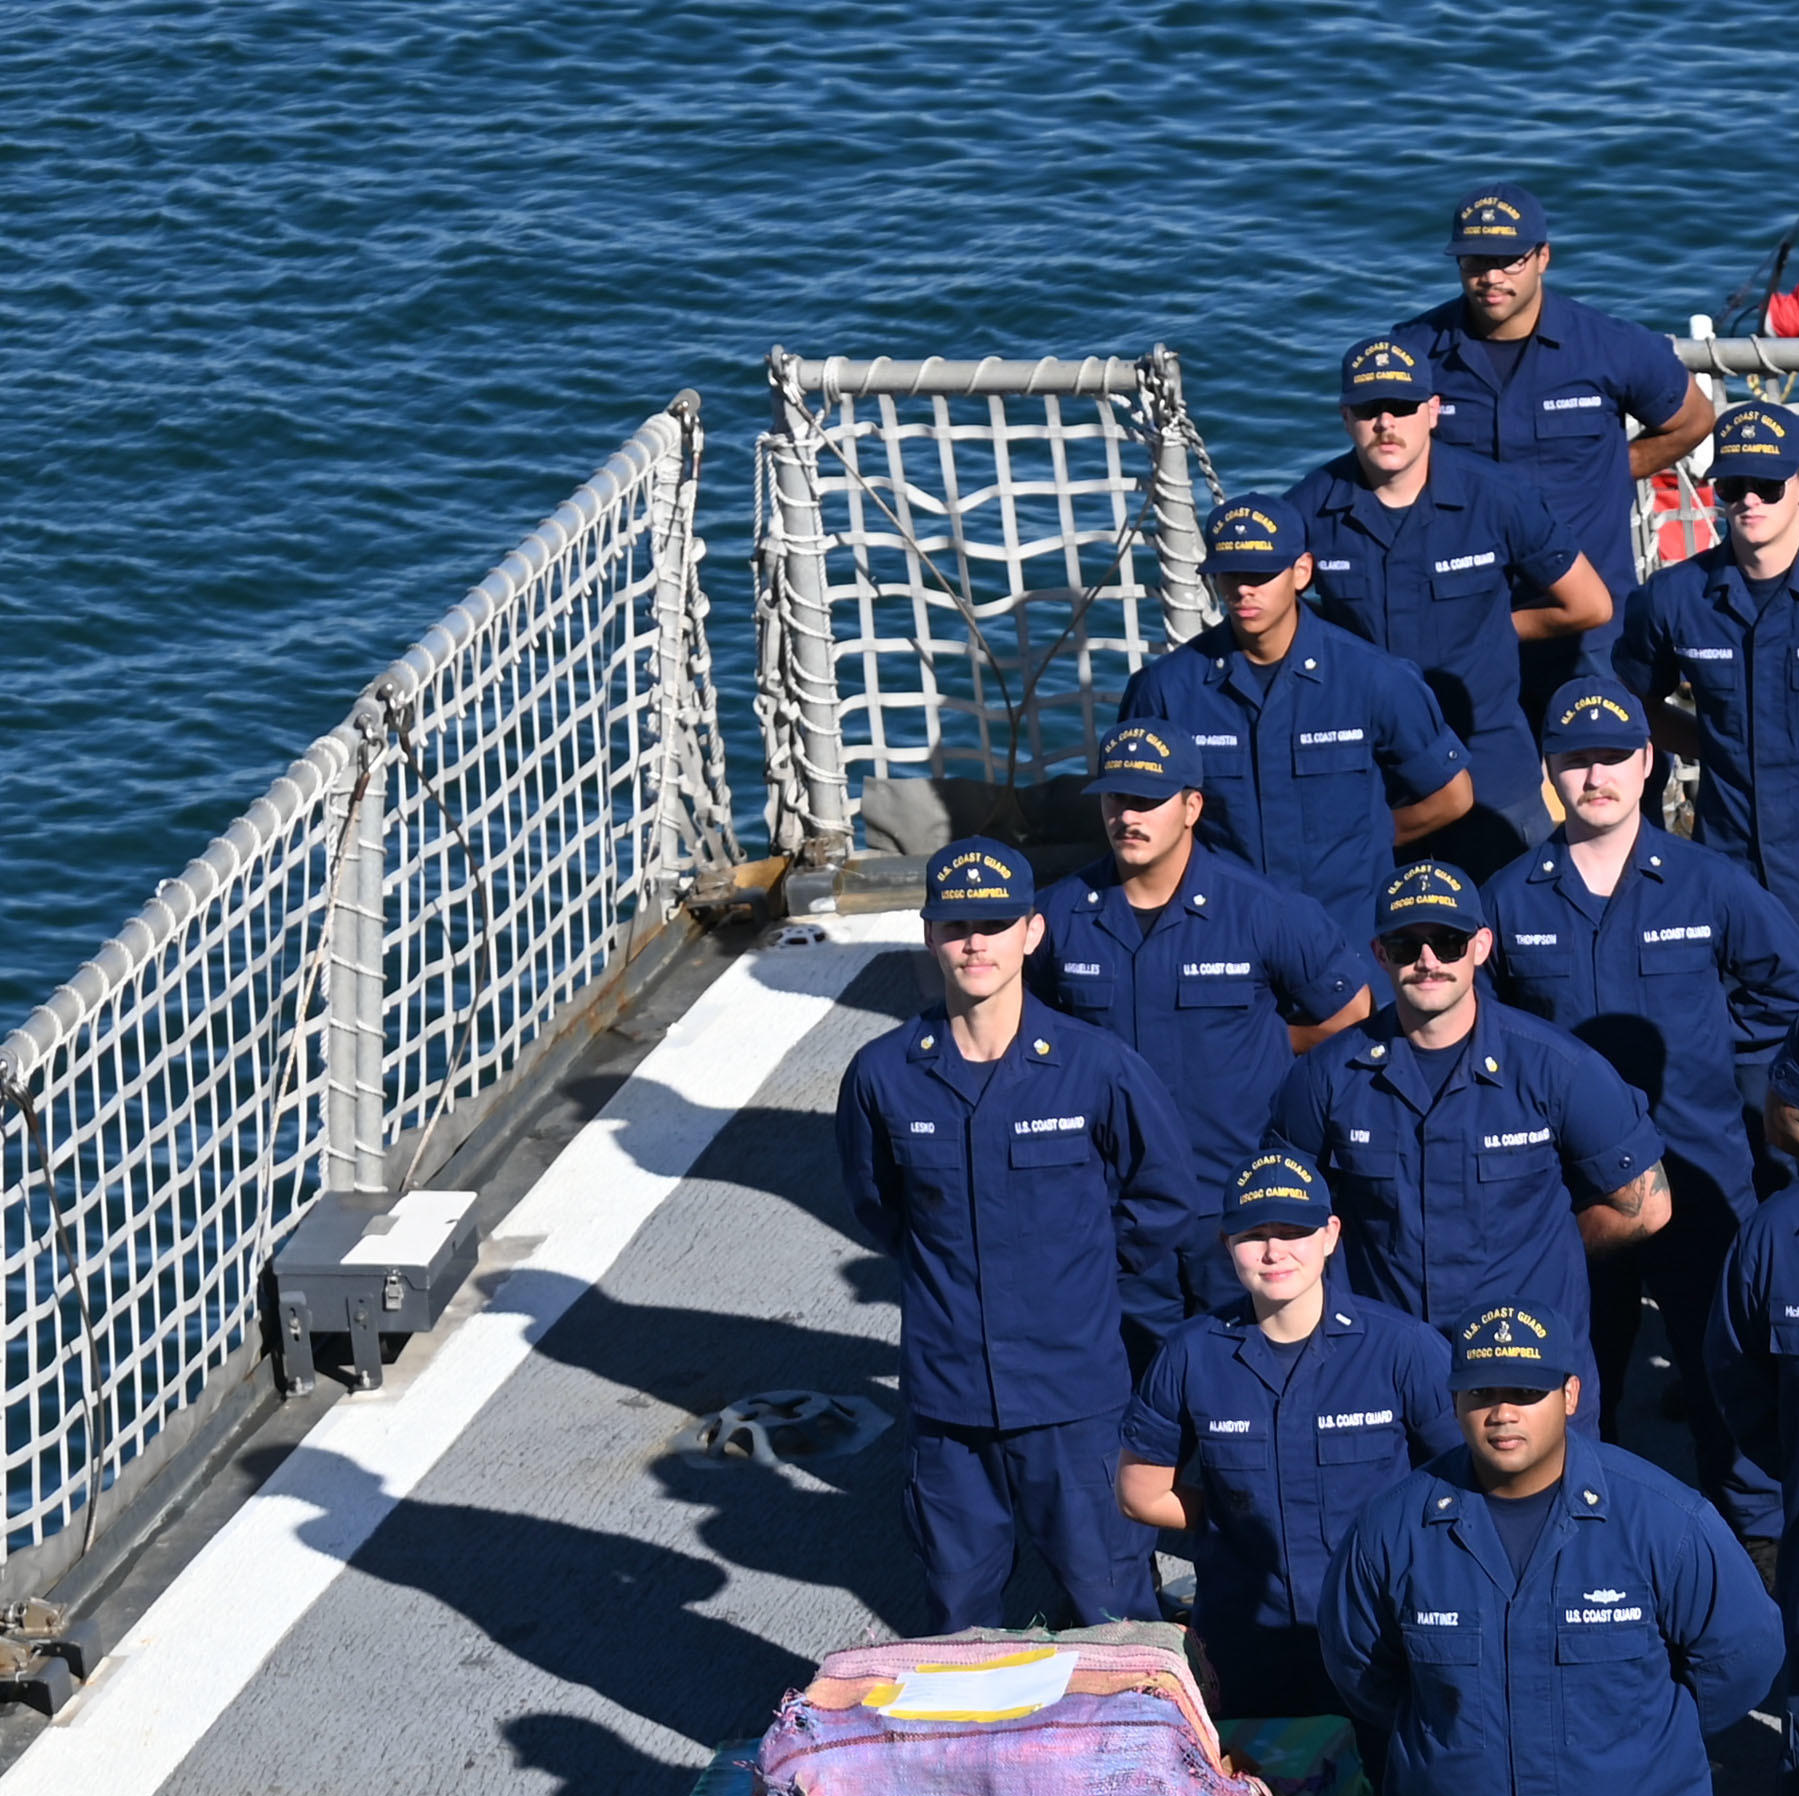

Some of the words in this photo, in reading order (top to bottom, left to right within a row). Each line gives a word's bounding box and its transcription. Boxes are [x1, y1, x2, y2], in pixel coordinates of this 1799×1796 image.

[1515, 933, 1557, 946] THOMPSON
[1643, 929, 1659, 944] U.S.
[1657, 927, 1686, 942] COAST
[1685, 925, 1712, 940] GUARD
[1014, 1120, 1031, 1135] U.S.
[1029, 1118, 1058, 1133] COAST
[1056, 1115, 1085, 1131] GUARD
[1463, 1322, 1481, 1340] U.S.
[1481, 1306, 1515, 1325] COAST
[1517, 1311, 1547, 1339] GUARD
[1466, 1346, 1494, 1360] USCGC
[1494, 1346, 1542, 1360] CAMPBELL
[1317, 1414, 1336, 1430] U.S.
[1335, 1412, 1365, 1429] COAST
[1364, 1409, 1393, 1426] GUARD
[1417, 1611, 1459, 1626] MARTINEZ
[1565, 1609, 1582, 1624] U.S.
[1582, 1608, 1613, 1624] COAST
[1612, 1607, 1642, 1623] GUARD
